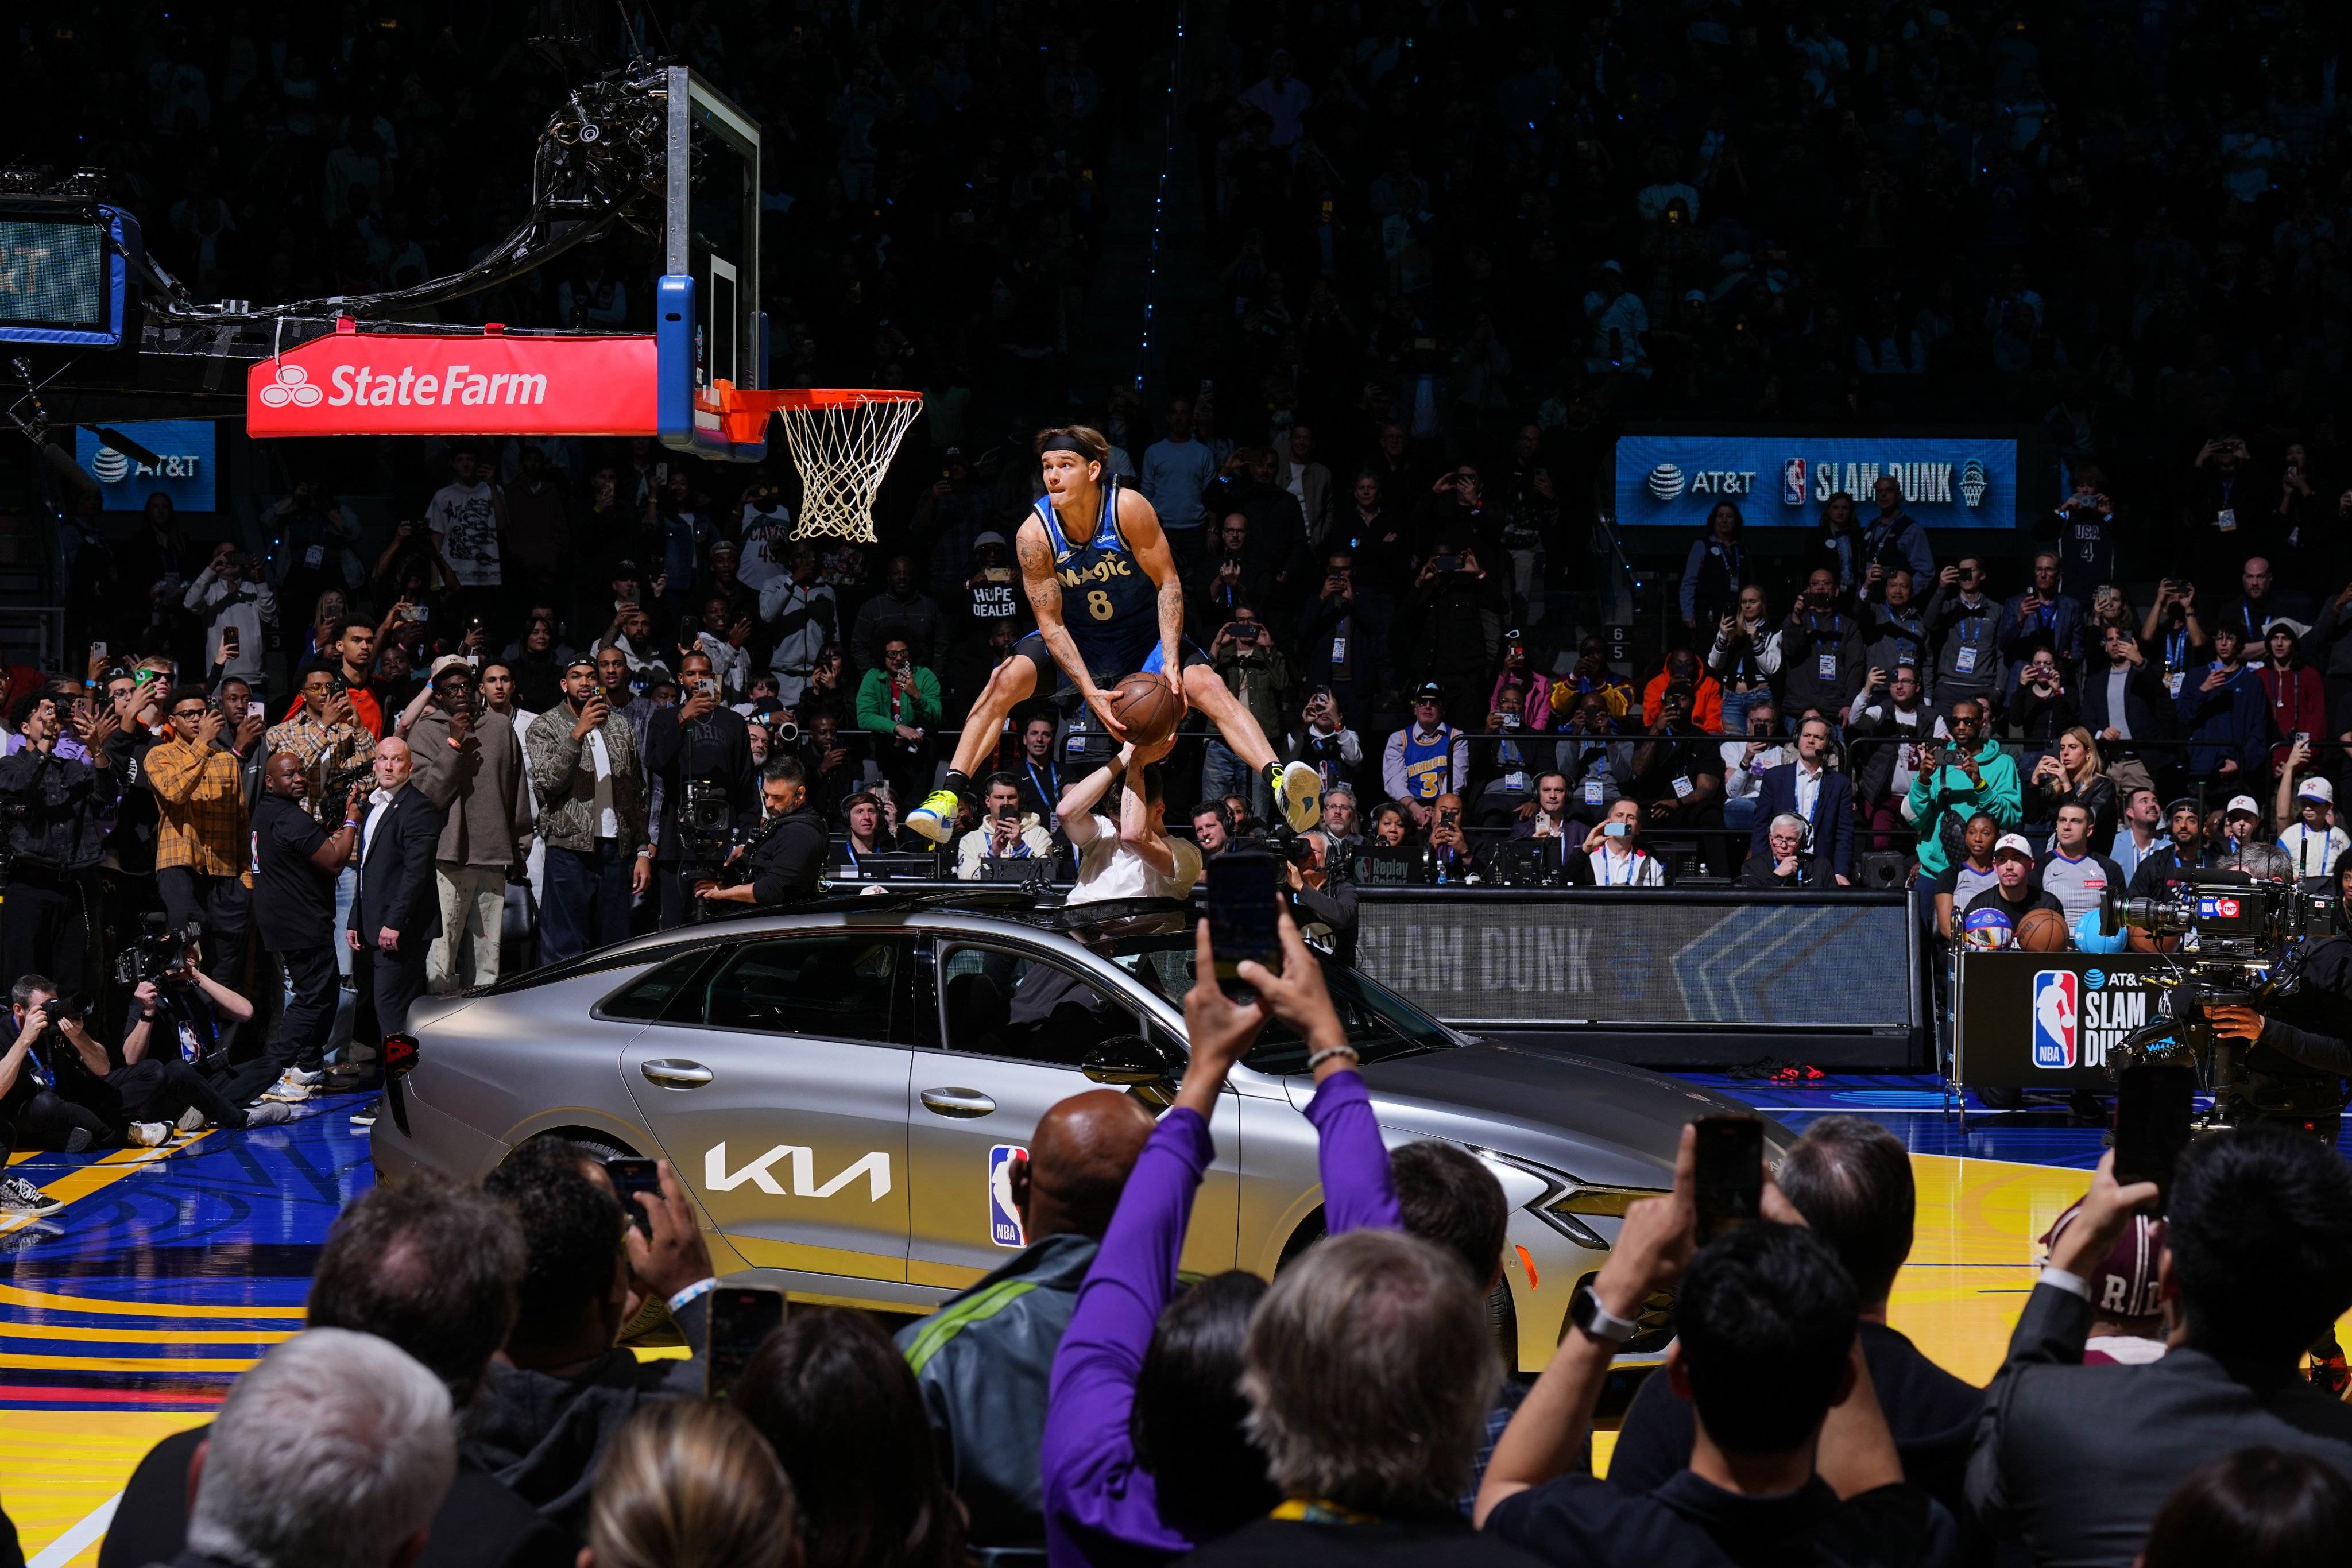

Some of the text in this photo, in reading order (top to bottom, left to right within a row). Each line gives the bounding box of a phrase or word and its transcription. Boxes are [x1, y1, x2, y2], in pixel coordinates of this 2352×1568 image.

[134, 454, 199, 477] AT&T
[1691, 471, 1757, 494] AT&T
[1815, 462, 1952, 502] SLAM DUNK
[1094, 534, 1116, 544] Disney
[2075, 524, 2100, 540] USA
[2080, 541, 2094, 562] 4
[973, 602, 1016, 617] DEALER
[1087, 590, 1114, 621] 8
[271, 635, 281, 648] 3
[1614, 628, 1623, 641] 6
[1614, 646, 1623, 659] 5
[690, 724, 727, 745] ARIS
[1373, 857, 1409, 878] Replay
[2202, 902, 2214, 913] NBA
[1356, 925, 1594, 993] SLAM DUNK
[2108, 973, 2143, 987] AT&
[2084, 991, 2146, 1029] SLAM
[2039, 1046, 2060, 1062] NBA
[705, 1141, 891, 1202] KIA
[996, 1224, 1016, 1241] NBA
[2100, 1273, 2127, 1313] R
